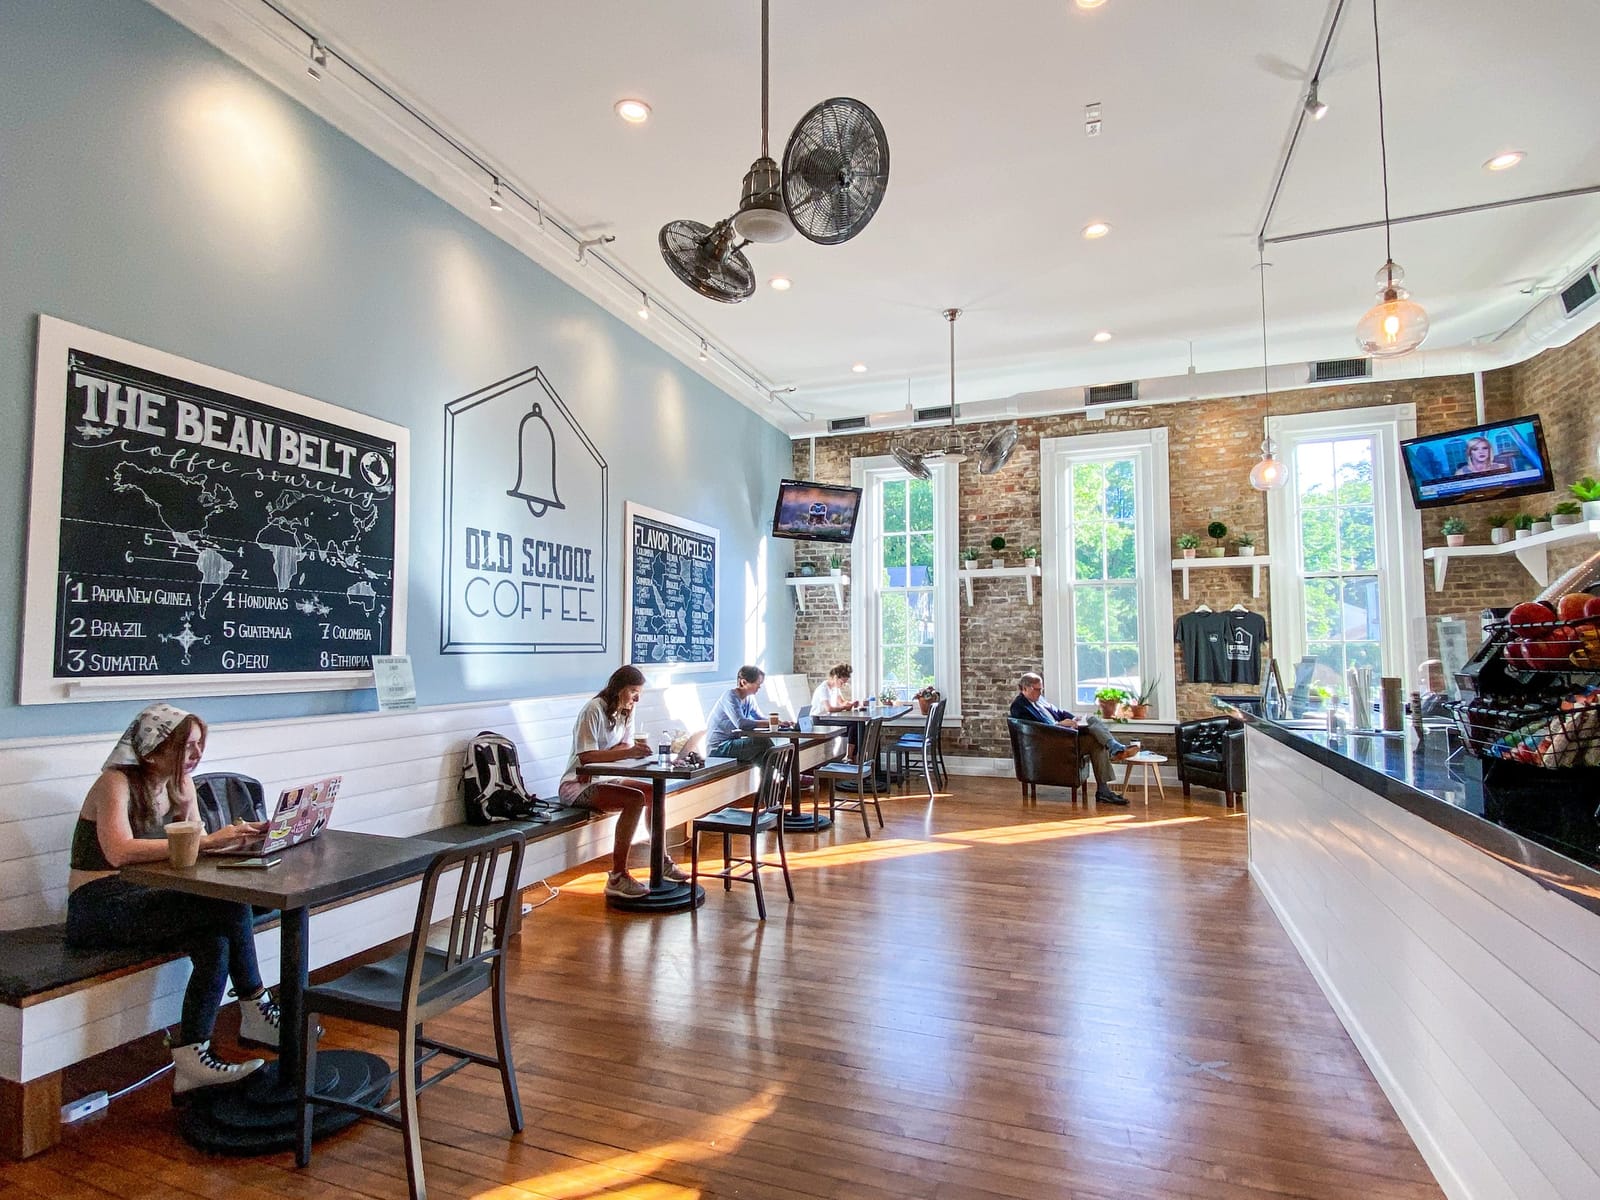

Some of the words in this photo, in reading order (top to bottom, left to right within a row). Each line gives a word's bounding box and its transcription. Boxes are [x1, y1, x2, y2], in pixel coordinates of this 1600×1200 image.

[75, 372, 166, 437] THE
[175, 400, 275, 461] BEAN
[278, 426, 357, 479] BELT
[72, 439, 240, 473] coffee
[240, 467, 391, 508] sourcing
[143, 533, 153, 546] 5
[634, 524, 669, 552] FLAVOR
[671, 533, 713, 562] PROFILES
[125, 550, 135, 563] 6
[168, 545, 179, 558] 7
[465, 527, 513, 574] OLD
[522, 537, 595, 584] SCHOOL
[241, 568, 250, 580] 2
[71, 582, 89, 603] 1
[91, 585, 125, 603] PAPUA
[126, 586, 153, 604] NEW
[154, 589, 192, 606] GUINEA
[222, 591, 236, 609] 4
[238, 592, 289, 611] HONDURAS
[465, 576, 595, 623] COFFEE
[69, 617, 88, 638] 2
[90, 619, 147, 638] BRAZIL
[223, 620, 236, 639] 5
[238, 623, 293, 640] GUATEMALA
[318, 622, 331, 640] 7
[332, 626, 372, 641] COLOMBIA
[67, 649, 88, 672] 3
[88, 653, 159, 672] SUMATRA
[221, 650, 236, 670] 6
[236, 654, 270, 669] PERU
[319, 651, 330, 668] 8
[330, 653, 370, 667] ETHIOPIA
